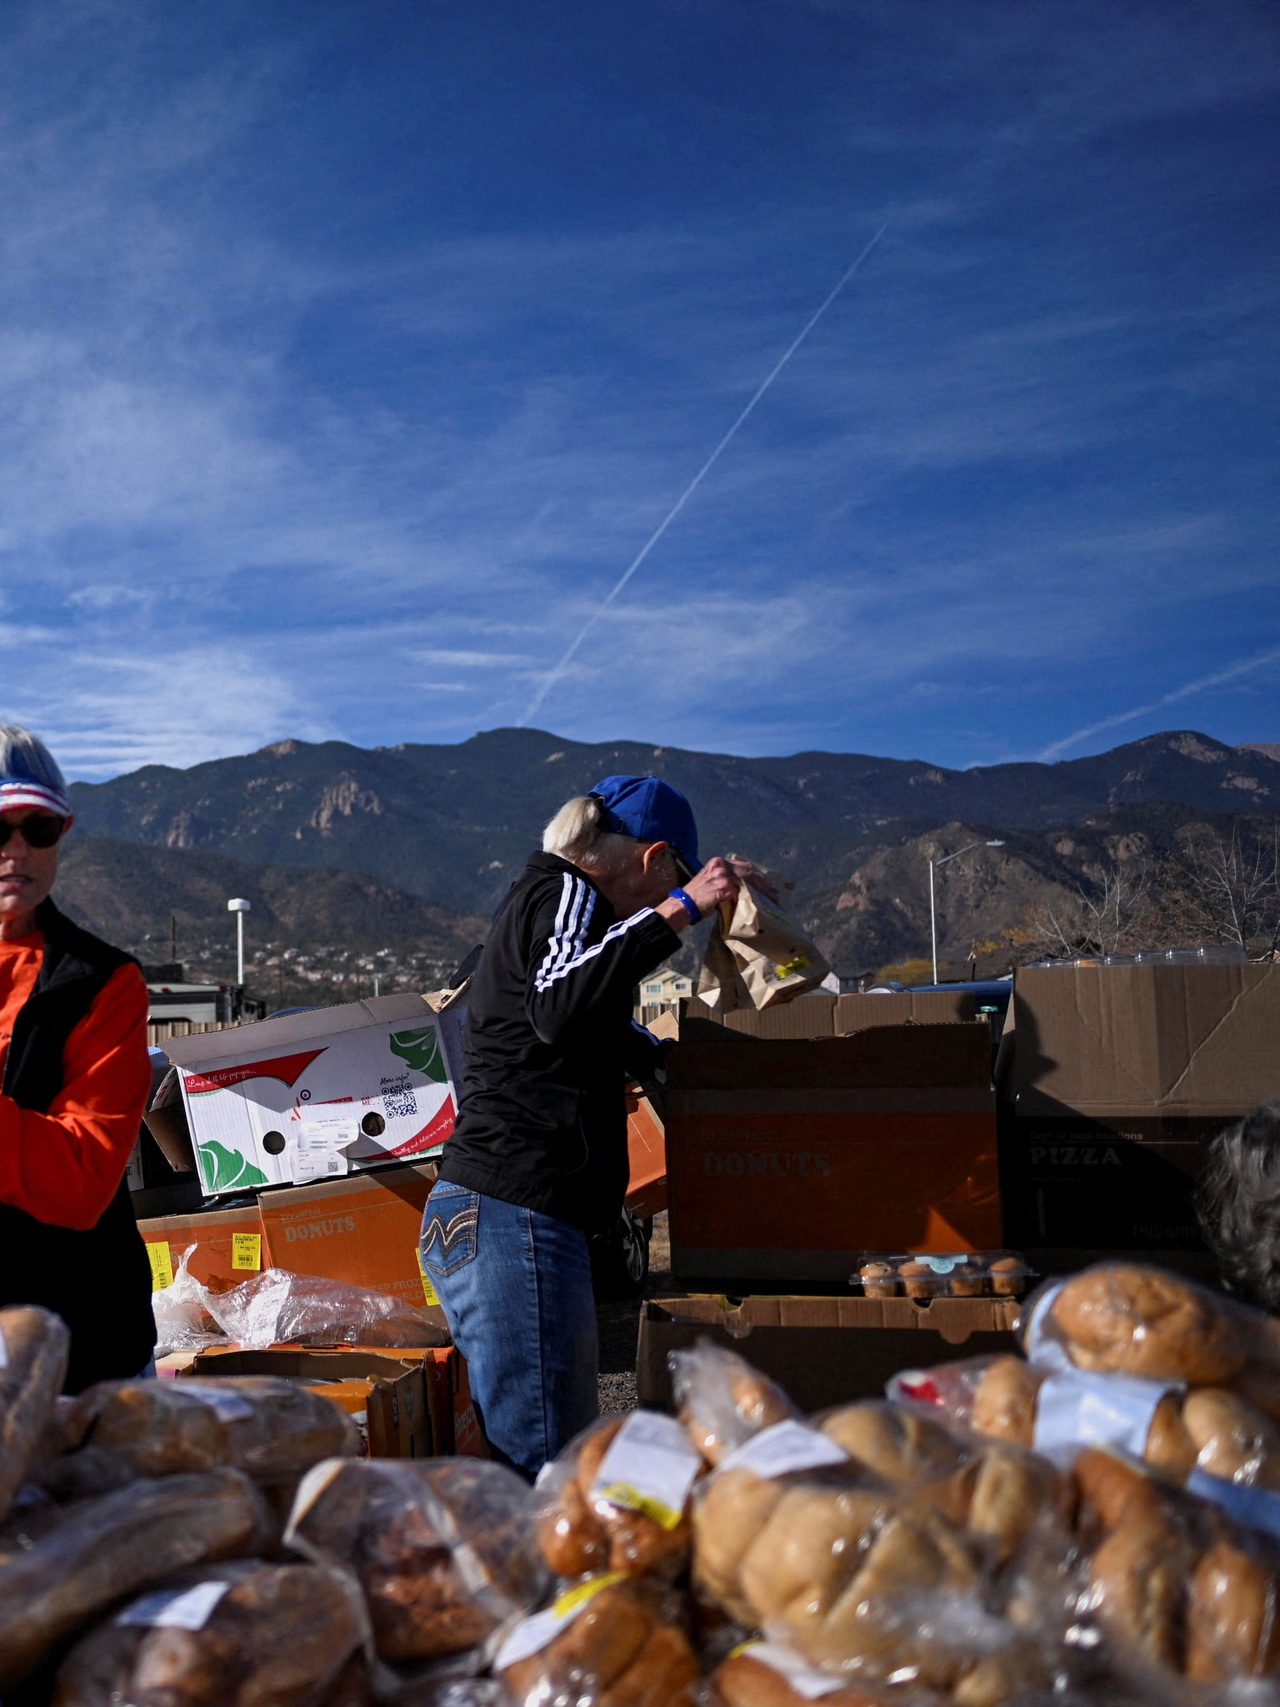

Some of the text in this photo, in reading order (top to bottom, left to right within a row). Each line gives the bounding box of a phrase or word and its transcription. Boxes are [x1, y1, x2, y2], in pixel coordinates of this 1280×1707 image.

[702, 1152, 831, 1178] DONUTS
[1029, 1147, 1123, 1166] PIZZA
[280, 1208, 322, 1222] Breakfast
[284, 1215, 357, 1243] DONUTS
[369, 1282, 391, 1293] EEP
